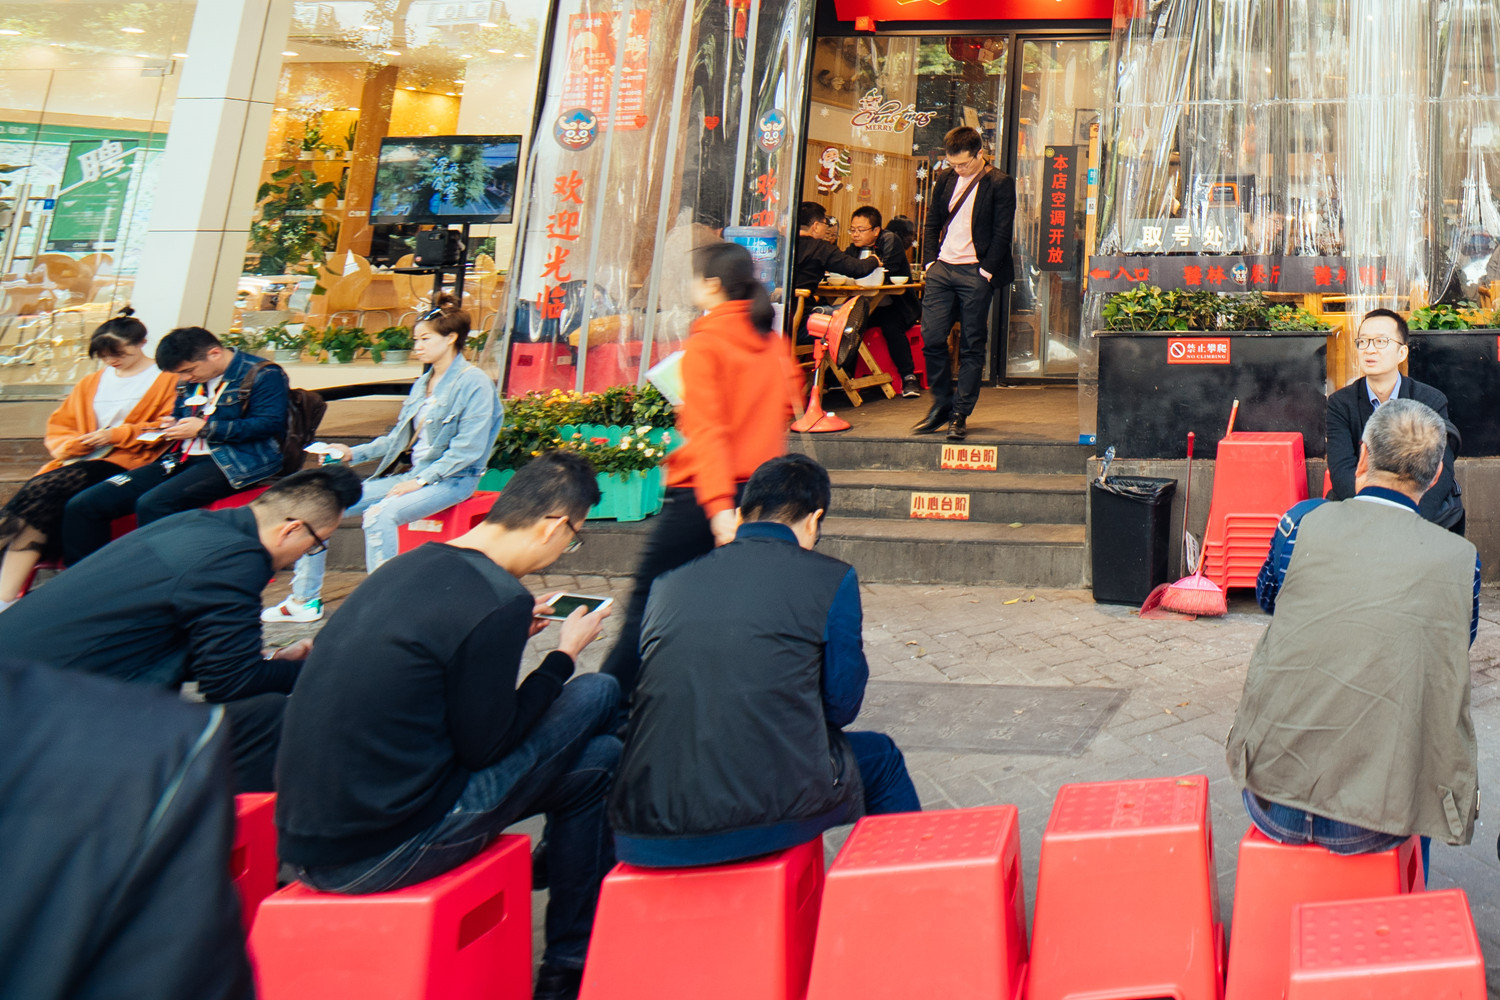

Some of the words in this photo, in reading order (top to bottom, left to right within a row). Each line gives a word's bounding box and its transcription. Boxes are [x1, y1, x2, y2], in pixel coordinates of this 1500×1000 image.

[850, 100, 937, 130] Christmas
[1047, 154, 1069, 263] 本店空调开放
[537, 170, 584, 319] 欢迎光临
[1141, 225, 1224, 247] 取号处
[1114, 265, 1150, 282] 入口
[1187, 343, 1227, 353] 禁止攀爬
[944, 448, 994, 462] 小心台阶
[914, 496, 966, 511] 小心台阶
